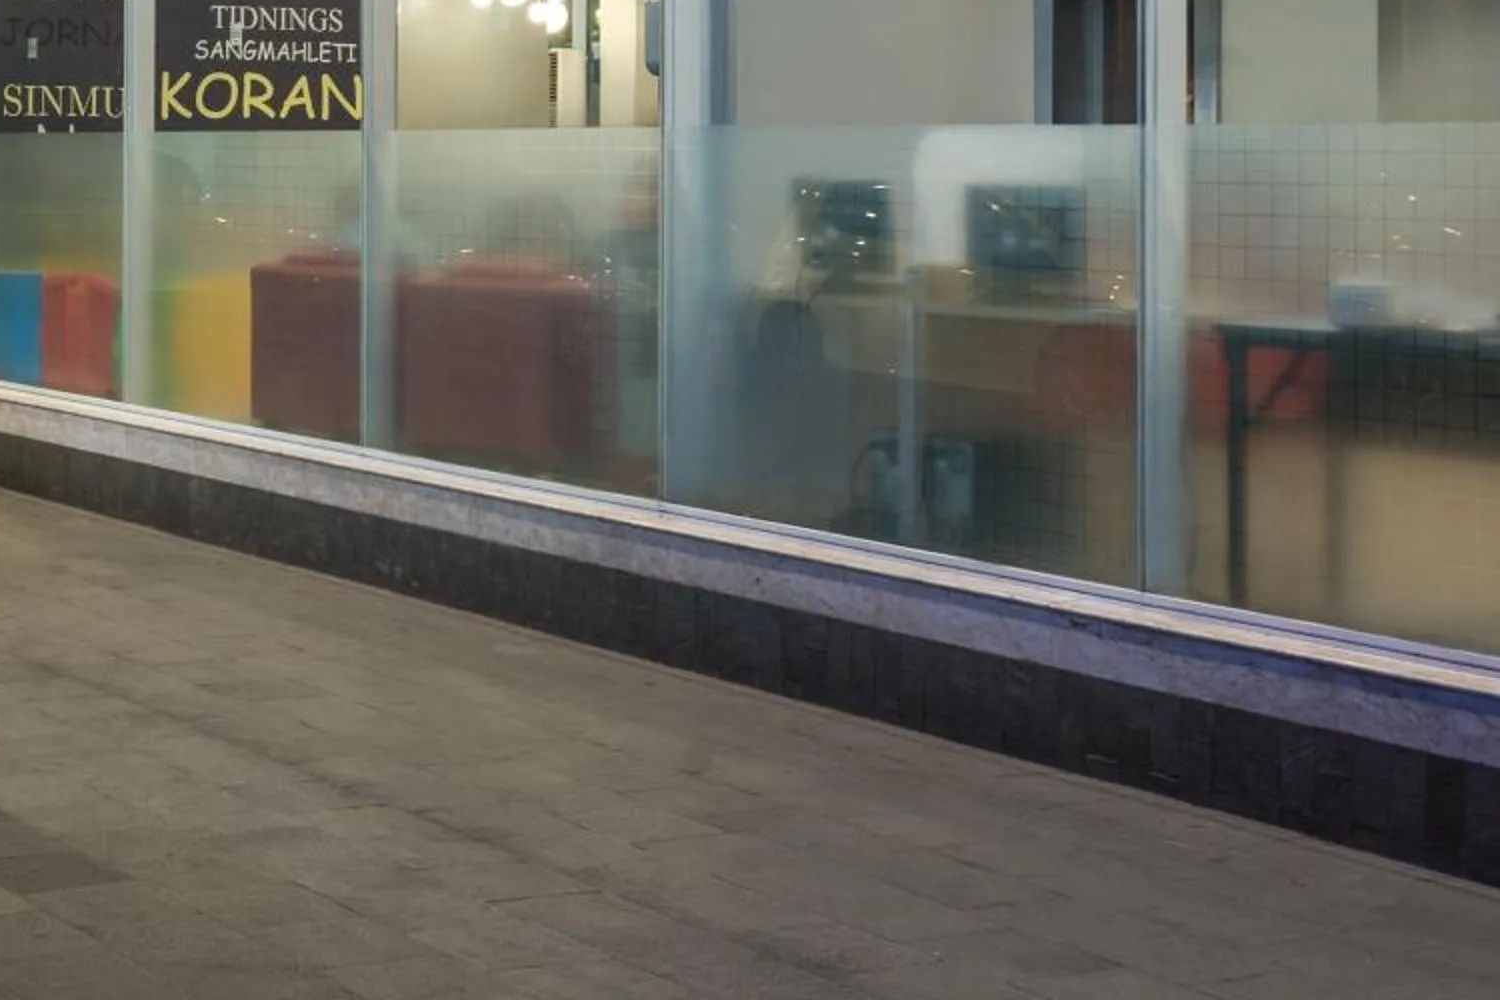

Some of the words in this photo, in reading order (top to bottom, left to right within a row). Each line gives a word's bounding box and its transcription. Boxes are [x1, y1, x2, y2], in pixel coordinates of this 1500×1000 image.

[210, 4, 344, 33] TIDNINGS
[3, 83, 125, 118] SINMU
[161, 70, 363, 121] KORAN
